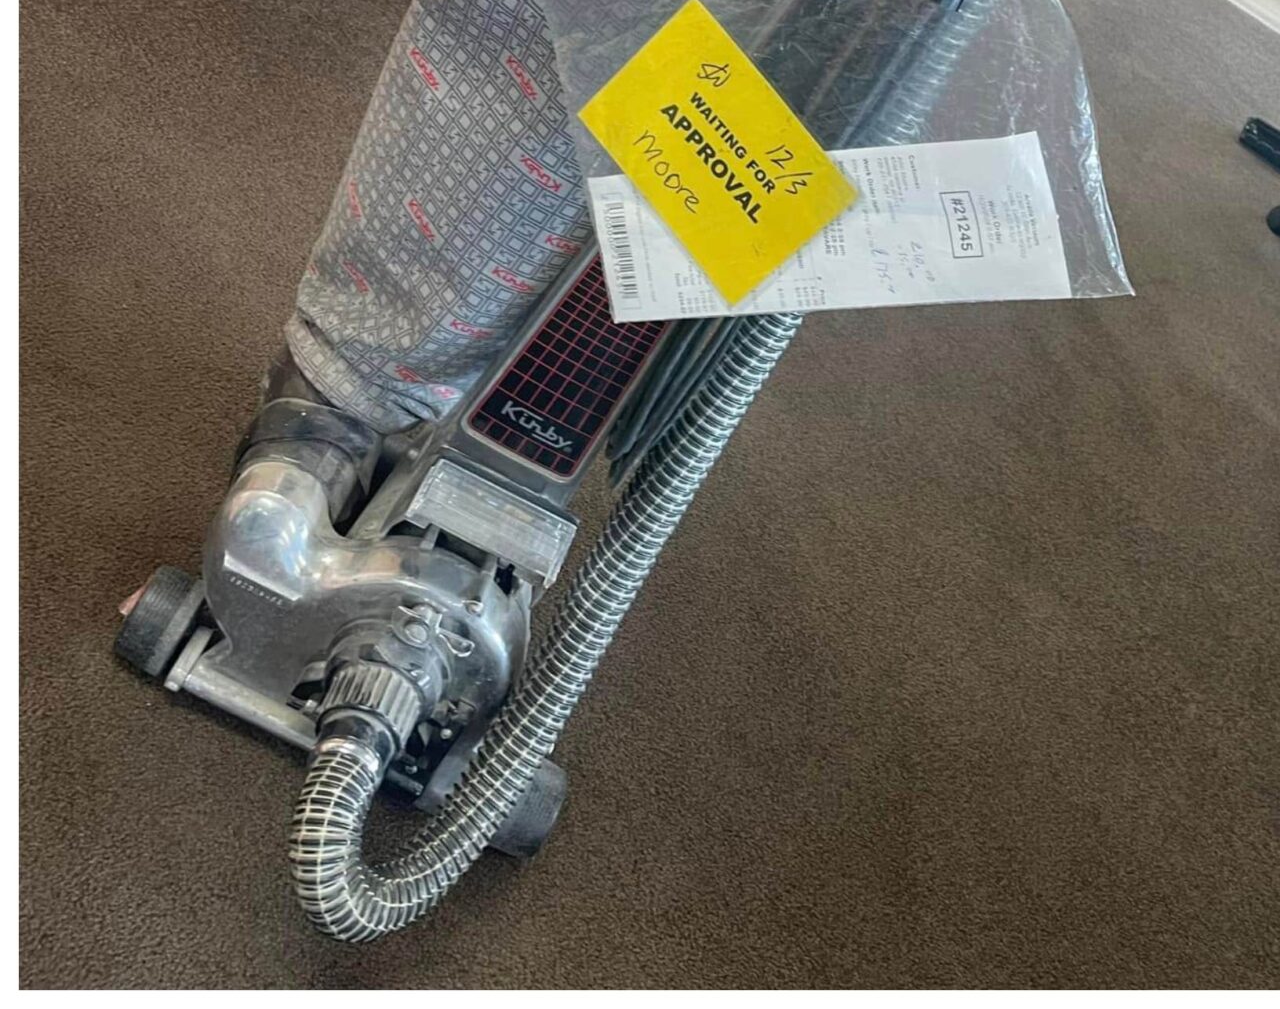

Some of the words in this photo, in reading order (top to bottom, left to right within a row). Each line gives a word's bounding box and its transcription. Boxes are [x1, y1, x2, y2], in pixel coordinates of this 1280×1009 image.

[506, 55, 537, 101] Kirby
[660, 104, 766, 225] APPROVAL
[690, 92, 748, 160] WAITING
[745, 159, 776, 195] FOR
[766, 144, 813, 196] 12/3
[950, 198, 974, 252] #21245
[501, 400, 573, 453] Kirby
